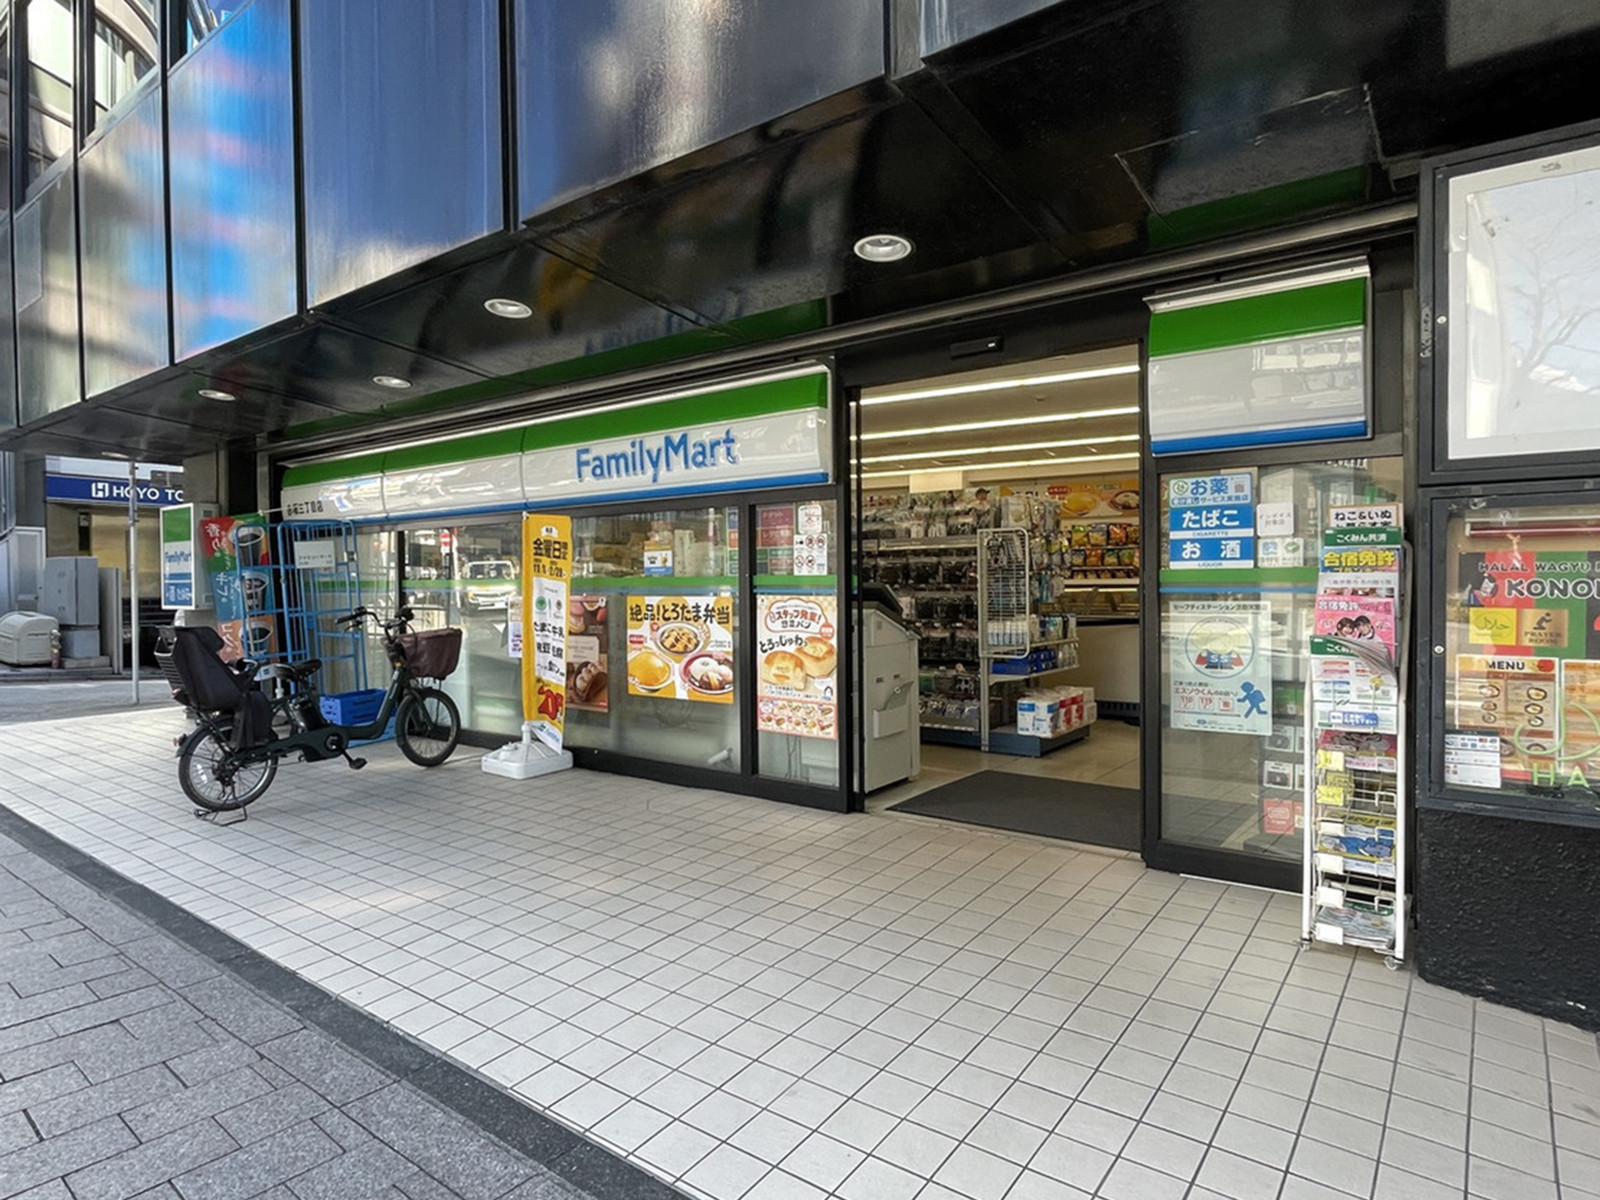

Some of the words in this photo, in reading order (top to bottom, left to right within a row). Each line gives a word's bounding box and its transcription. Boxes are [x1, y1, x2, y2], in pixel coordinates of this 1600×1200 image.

[576, 428, 737, 483] FamilyMart
[1190, 478, 1228, 495] お薬
[1182, 509, 1240, 529] たばこ
[1334, 509, 1392, 521] ねこ&いぬ
[1181, 540, 1241, 560] お酒
[1323, 550, 1395, 568] 合宿免許
[1478, 561, 1529, 572] HALAL
[1535, 561, 1591, 573] WAGYU
[1504, 578, 1600, 600] KONO
[1524, 631, 1563, 639] PRAYER
[1485, 660, 1526, 670] MENU
